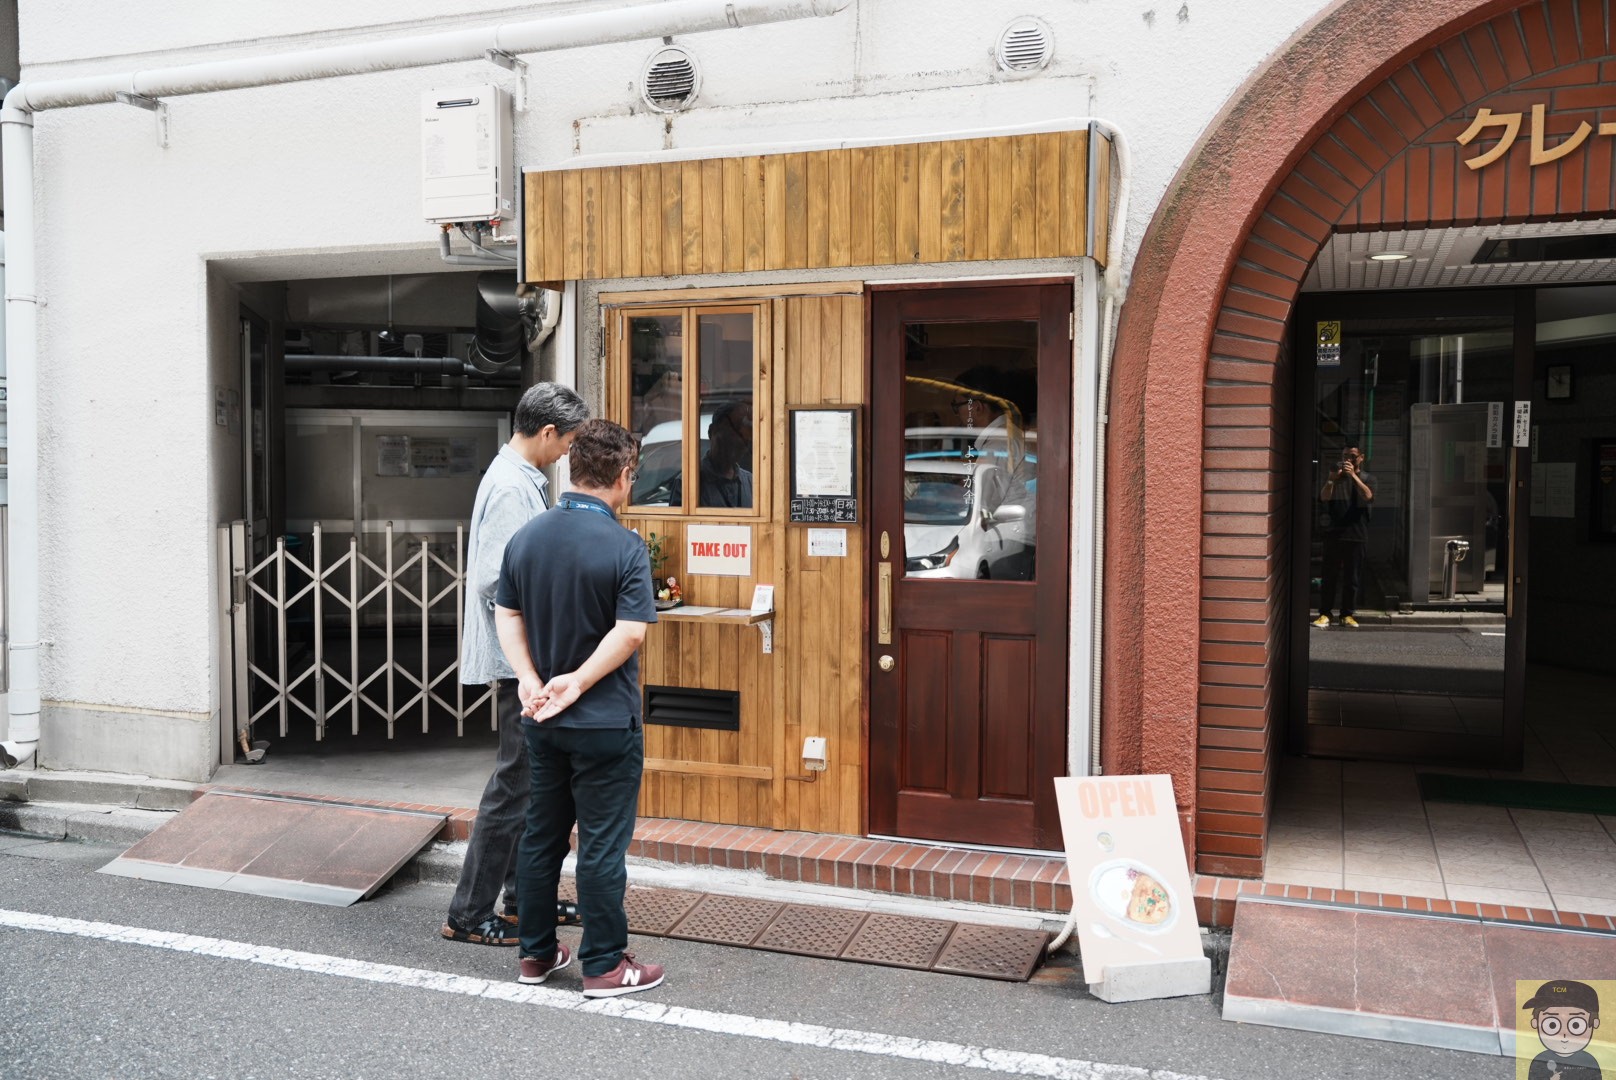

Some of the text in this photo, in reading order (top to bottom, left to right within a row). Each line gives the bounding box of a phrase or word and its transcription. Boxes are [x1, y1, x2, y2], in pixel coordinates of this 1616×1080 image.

[1456, 104, 1616, 170] クレ
[691, 542, 747, 558] TAKE OUT
[1078, 781, 1157, 819] OPEN
